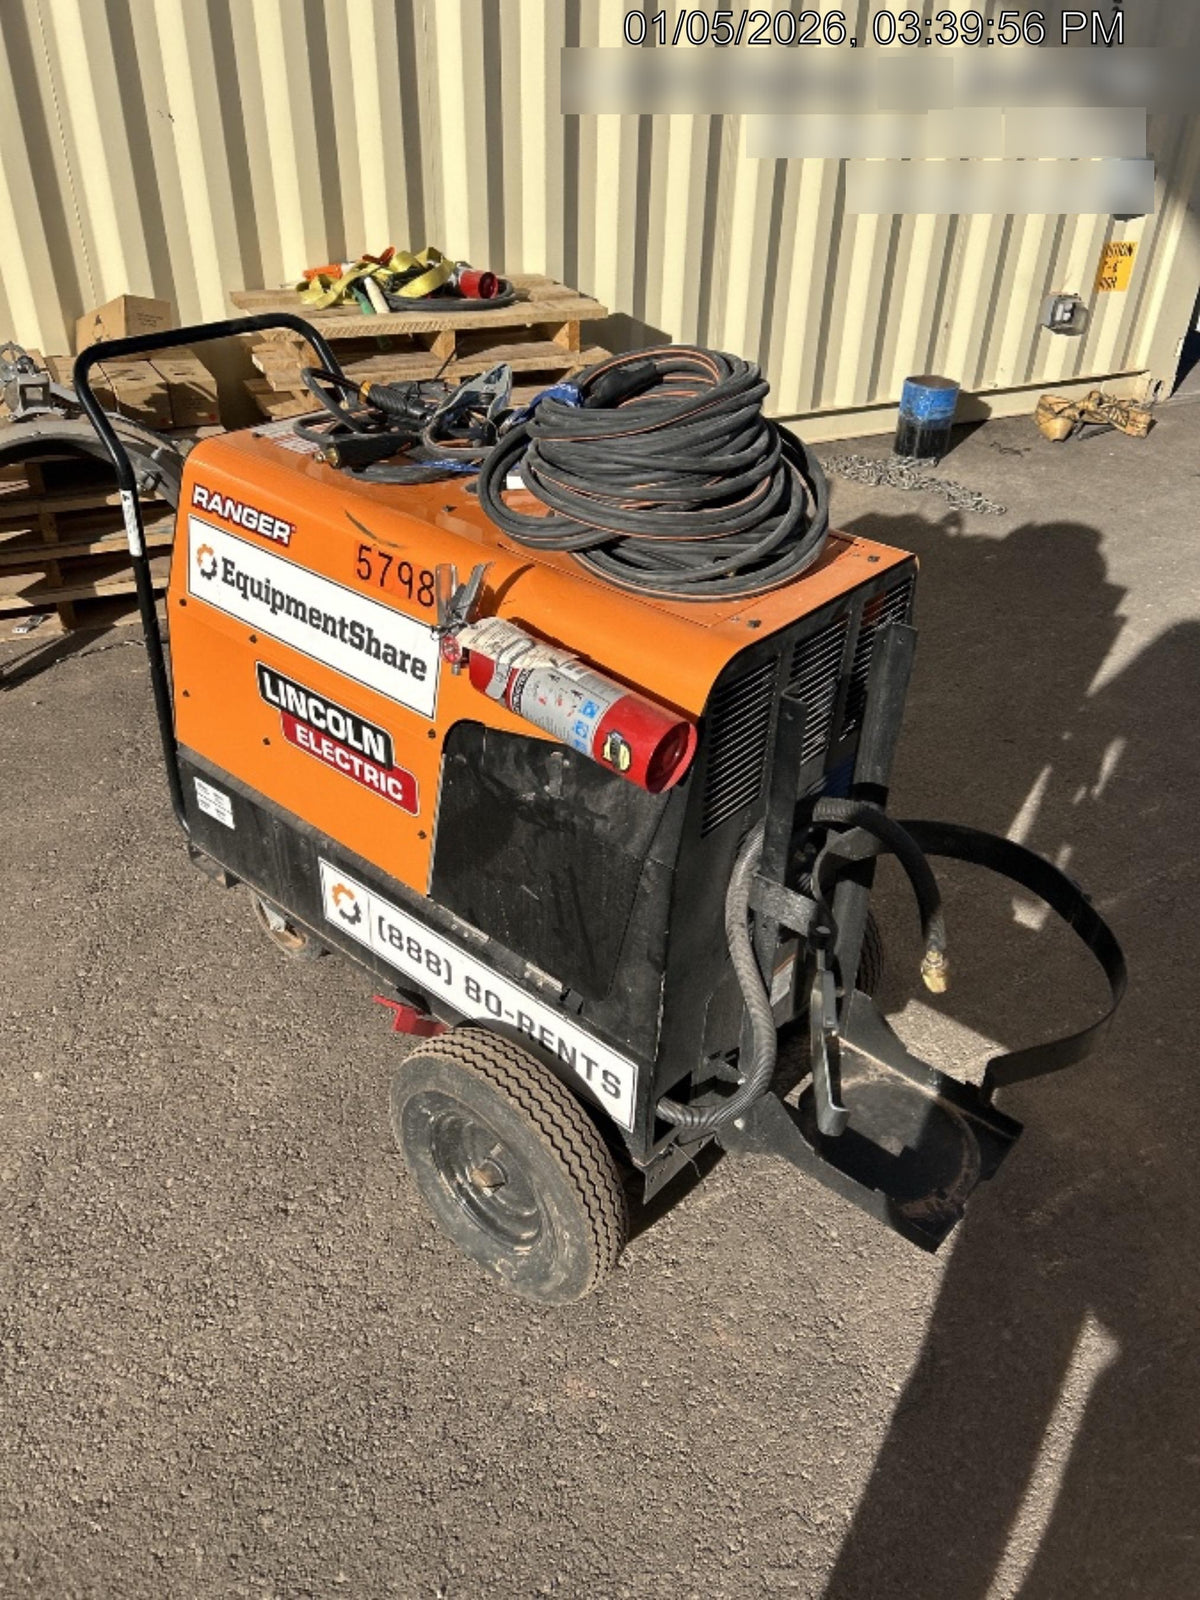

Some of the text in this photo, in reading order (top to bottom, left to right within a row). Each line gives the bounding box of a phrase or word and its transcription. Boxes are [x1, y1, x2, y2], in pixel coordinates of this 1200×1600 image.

[192, 484, 291, 546] RANGER
[357, 544, 435, 608] 5798
[221, 556, 428, 683] EquipmentShare
[261, 671, 386, 763] LINCOLN
[296, 724, 404, 801] ELECTRIC
[377, 914, 622, 1100] (888) 80-RENTS
